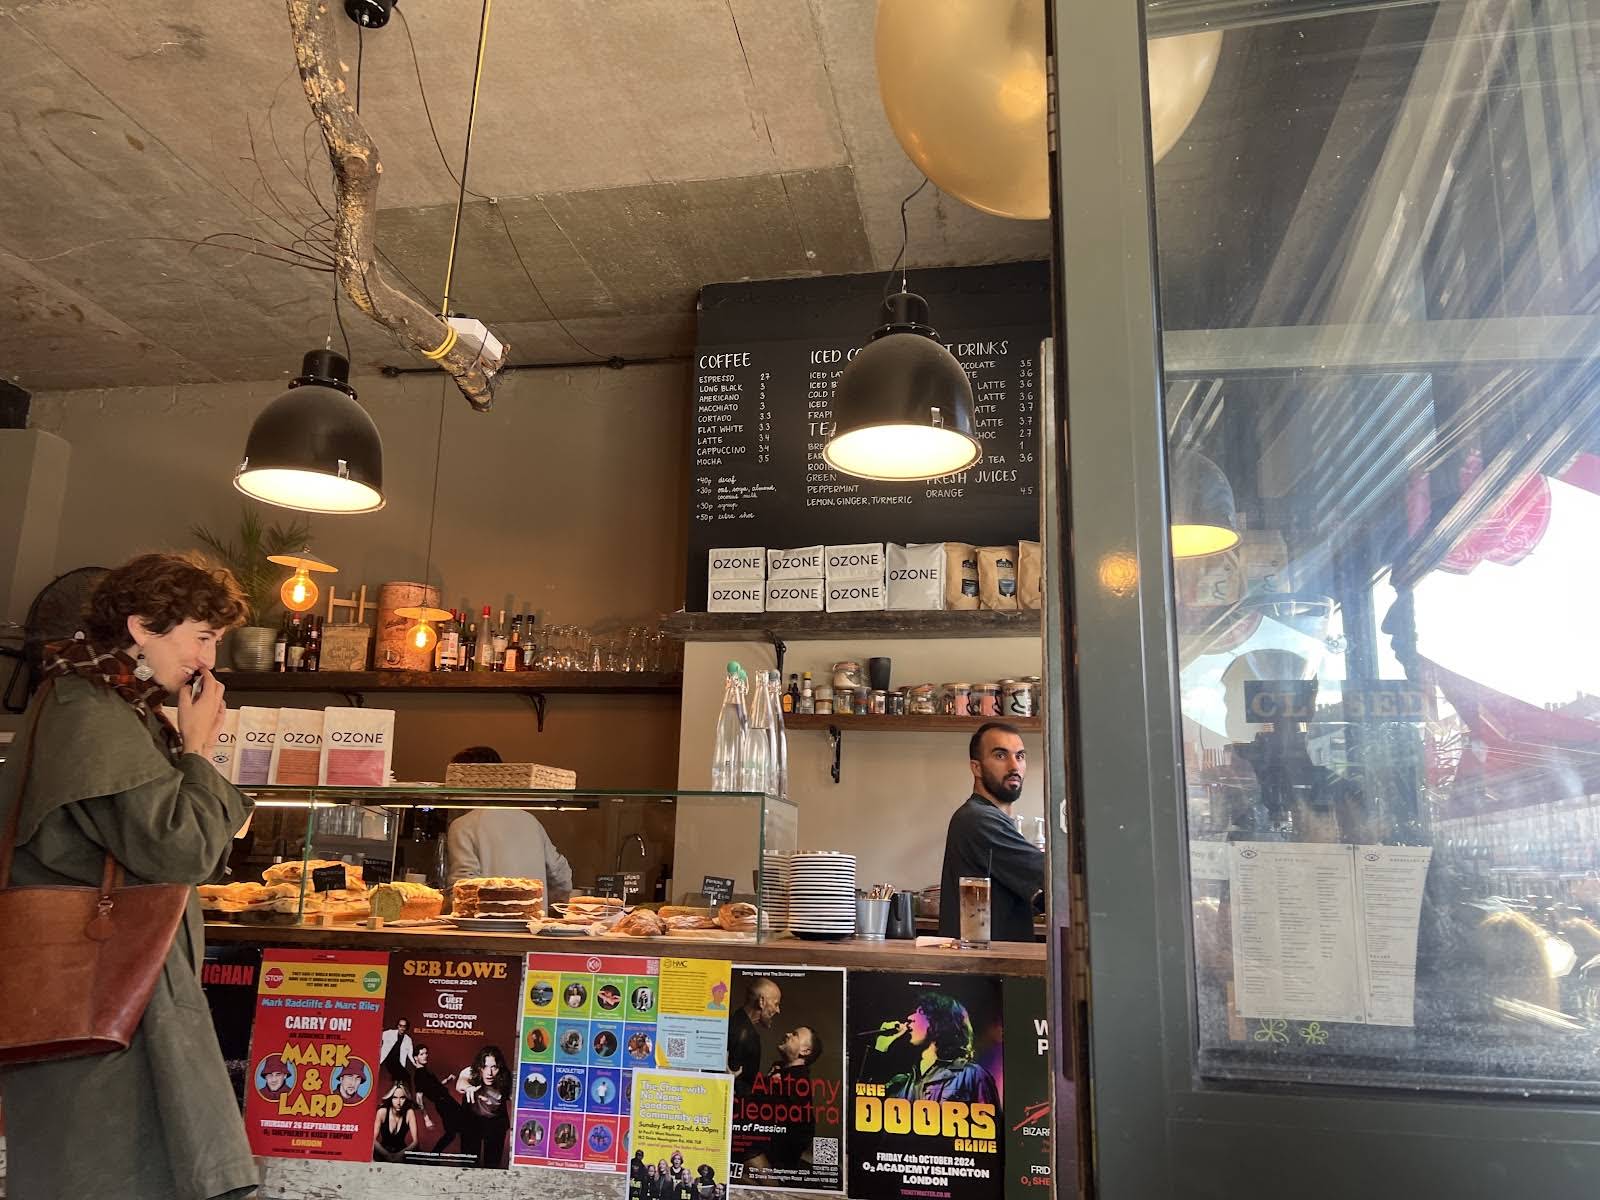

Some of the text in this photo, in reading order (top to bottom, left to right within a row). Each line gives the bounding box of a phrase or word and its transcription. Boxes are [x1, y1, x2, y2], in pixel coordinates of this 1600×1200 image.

[958, 341, 1008, 356] DRINKS
[700, 352, 751, 369] COFFEE
[811, 350, 841, 364] ICED
[699, 375, 735, 384] ESPRESSO
[699, 384, 743, 393] LONG BLACK
[978, 381, 1006, 390] LATTE
[699, 394, 739, 402] AMERICANO
[978, 393, 1006, 402] LATTE
[698, 404, 738, 412] MACCHIATO
[760, 402, 766, 410] 3
[976, 418, 1004, 427] LATTE
[698, 424, 744, 434] FLAT WHITE
[698, 436, 723, 445] LATTE
[697, 446, 746, 455] CAPPUCCINO
[989, 456, 1005, 464] TEA
[806, 474, 836, 482] GREEN
[975, 470, 1017, 483] JUICES
[807, 485, 860, 494] PEPPERMINT
[926, 489, 964, 498] ORANGE
[871, 496, 912, 504] TURMERIC
[713, 558, 760, 569] OZONE
[772, 557, 820, 569] OZONE
[830, 555, 878, 566] OZONE
[890, 569, 938, 581] OZONE
[712, 590, 760, 600] OZONE
[770, 588, 818, 599] OZONE
[830, 587, 879, 599] OZONE
[1252, 692, 1426, 717] CLSED
[332, 732, 384, 743] OZONE
[403, 960, 507, 978] SEB LOWE
[262, 998, 380, 1012] Mark Radcliffe & Marc Riley
[285, 1016, 352, 1031] CARRY ON!
[426, 1020, 473, 1029] LONDON
[281, 1042, 352, 1068] MARK
[302, 1068, 322, 1092] &
[641, 1080, 706, 1094] The Choir with
[752, 1072, 840, 1104] Antony
[856, 1083, 885, 1096] THE
[641, 1091, 683, 1101] No Name
[278, 1092, 344, 1117] LARD
[640, 1110, 691, 1122] Community
[856, 1096, 996, 1139] DOORS
[260, 1120, 292, 1128] THURSDAY
[303, 1122, 340, 1130] SEPTEMBER
[342, 1124, 358, 1132] 2024
[753, 1124, 787, 1133] Passion
[292, 1139, 322, 1147] LONDON
[955, 1139, 997, 1153] ALIVE
[877, 1152, 975, 1167] FRIDAY 4th OCTOBER 2024
[863, 1162, 990, 1179] O2 ACADEMY ISLINGTON
[903, 1175, 948, 1186] LONDON
